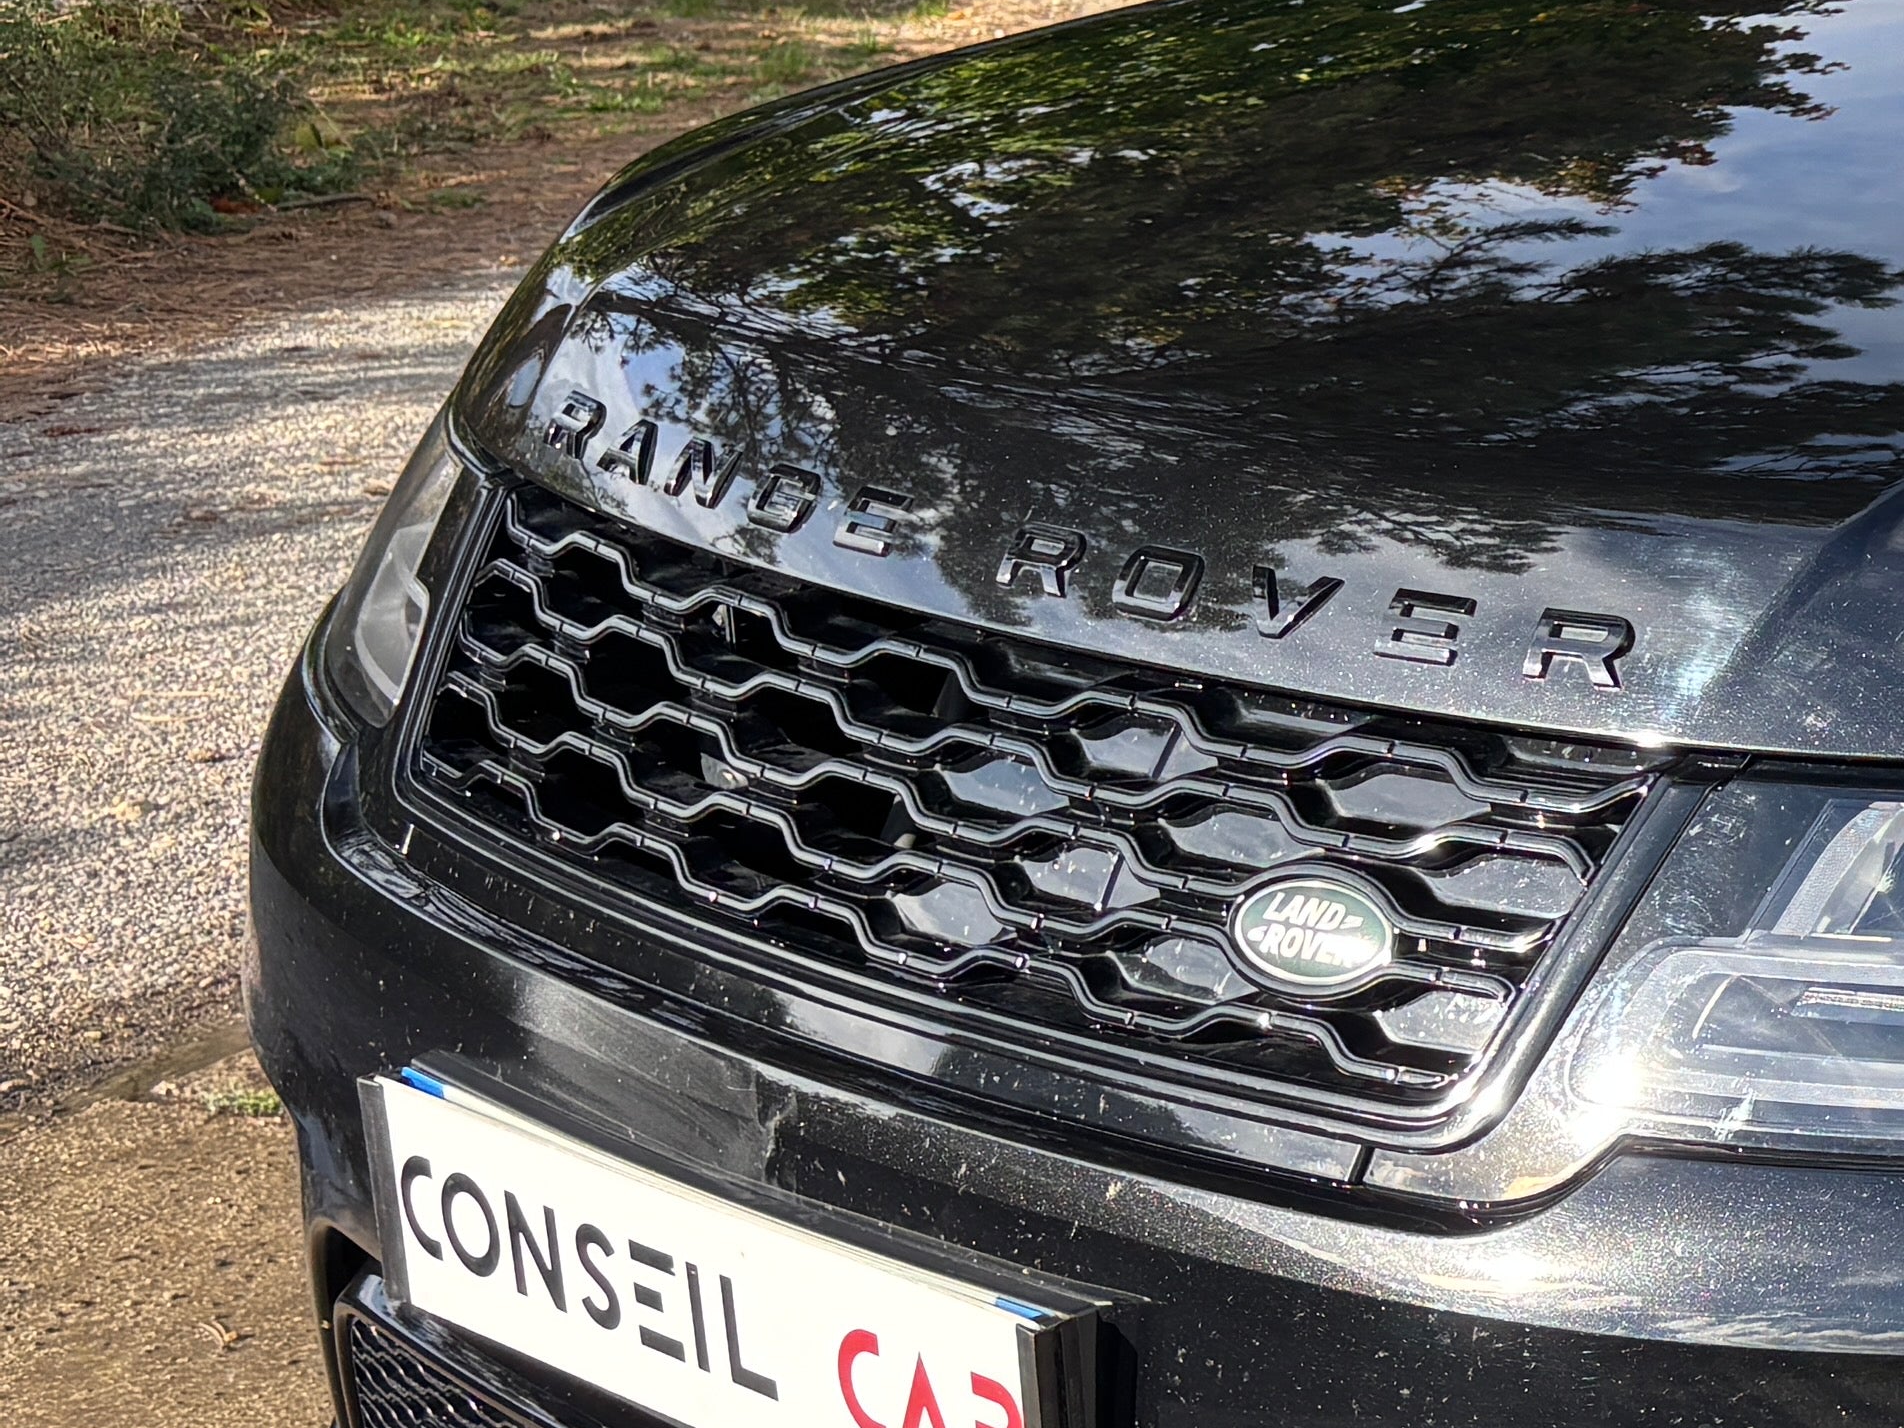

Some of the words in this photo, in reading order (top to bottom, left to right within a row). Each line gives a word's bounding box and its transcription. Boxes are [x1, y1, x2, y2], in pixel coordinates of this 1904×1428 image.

[543, 389, 915, 558] RANGE
[995, 523, 1636, 692] ROVER
[1262, 892, 1346, 931] LAND
[400, 1155, 778, 1402] CONSEIL
